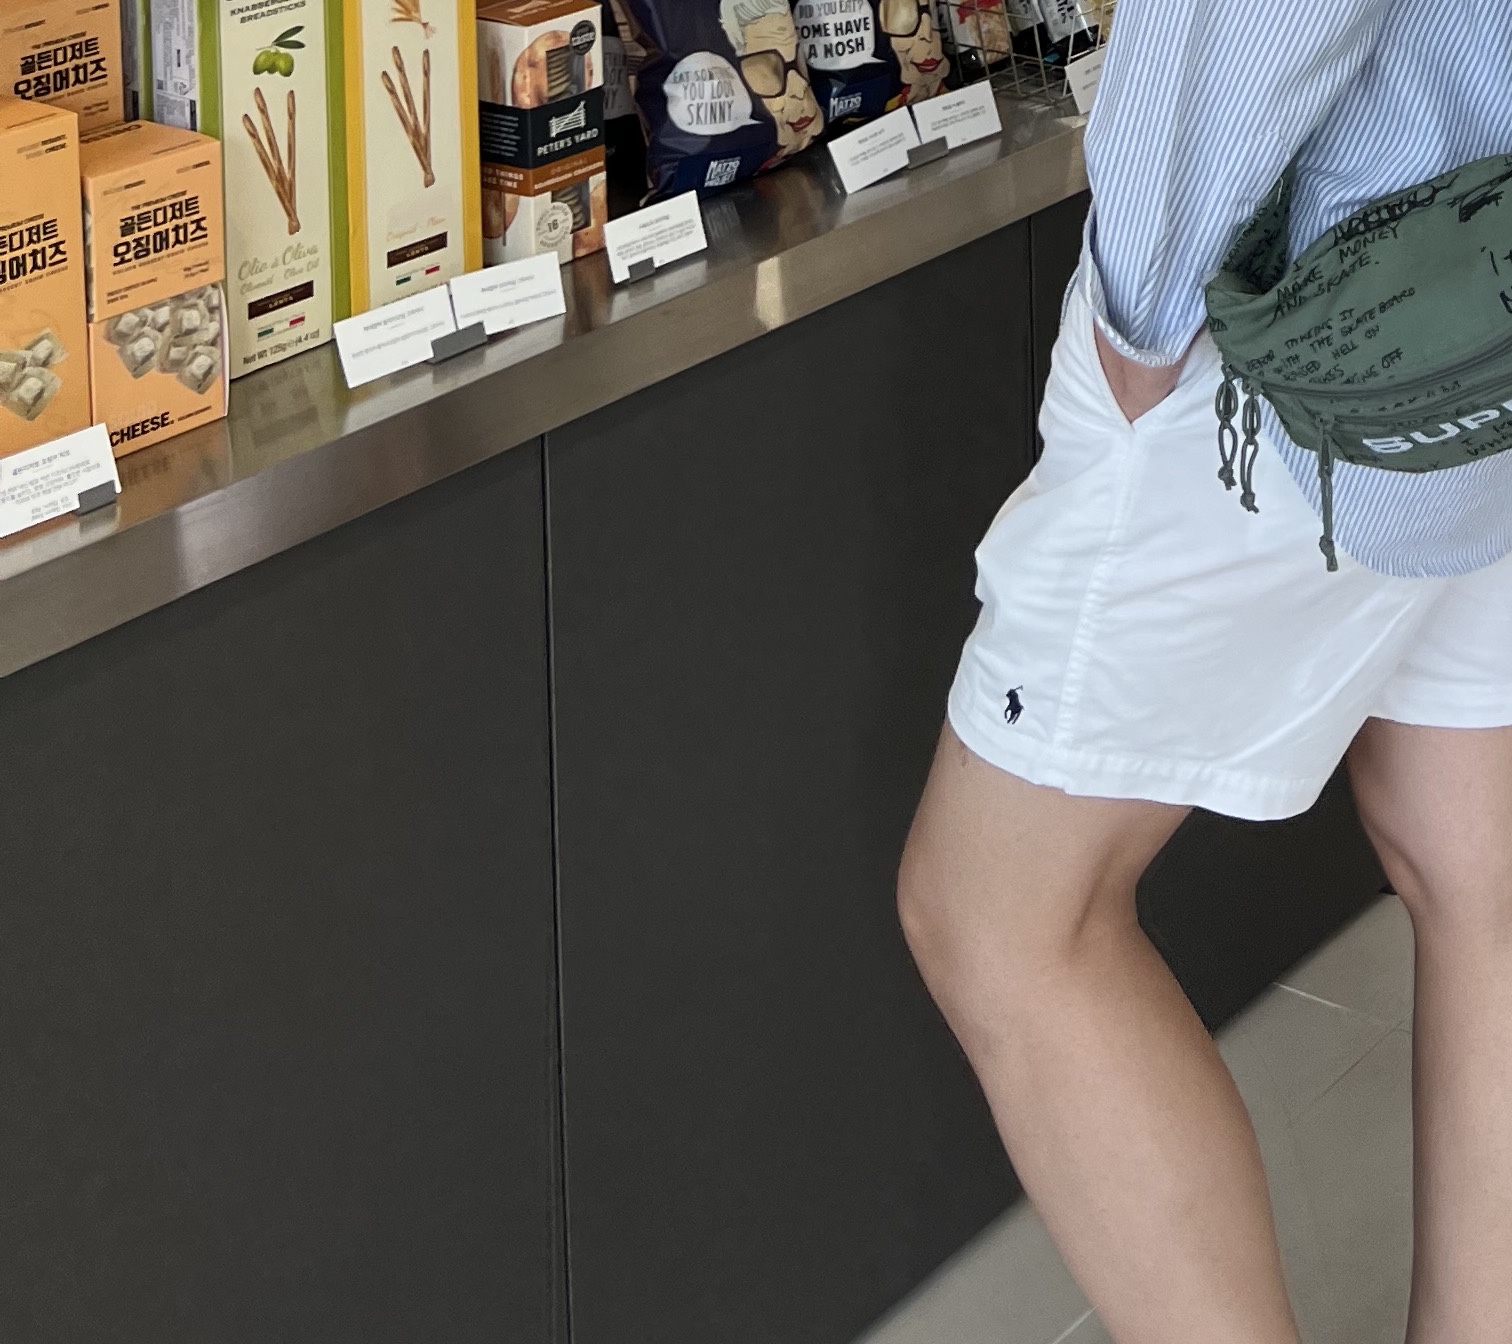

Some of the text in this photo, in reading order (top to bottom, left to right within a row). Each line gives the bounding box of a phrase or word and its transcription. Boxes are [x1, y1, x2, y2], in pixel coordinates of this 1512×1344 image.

[239, 0, 307, 25] BREADSTICKS
[816, 1, 838, 17] YOU
[834, 16, 871, 37] HAVE
[20, 36, 100, 76] 골든디저트
[807, 36, 866, 60] A NOSH
[14, 57, 108, 100] 오징어치즈
[682, 82, 706, 101] YOU
[686, 99, 735, 127] SKINNY
[829, 95, 863, 118] MATZO
[537, 127, 599, 157] PETER'S YARD
[706, 158, 741, 176] MATZO
[119, 195, 200, 238] 골든디저트
[112, 216, 208, 268] 오징어치즈
[1338, 221, 1401, 264] MONEY
[1309, 333, 1334, 353] THE
[109, 411, 174, 448] CHEESE.
